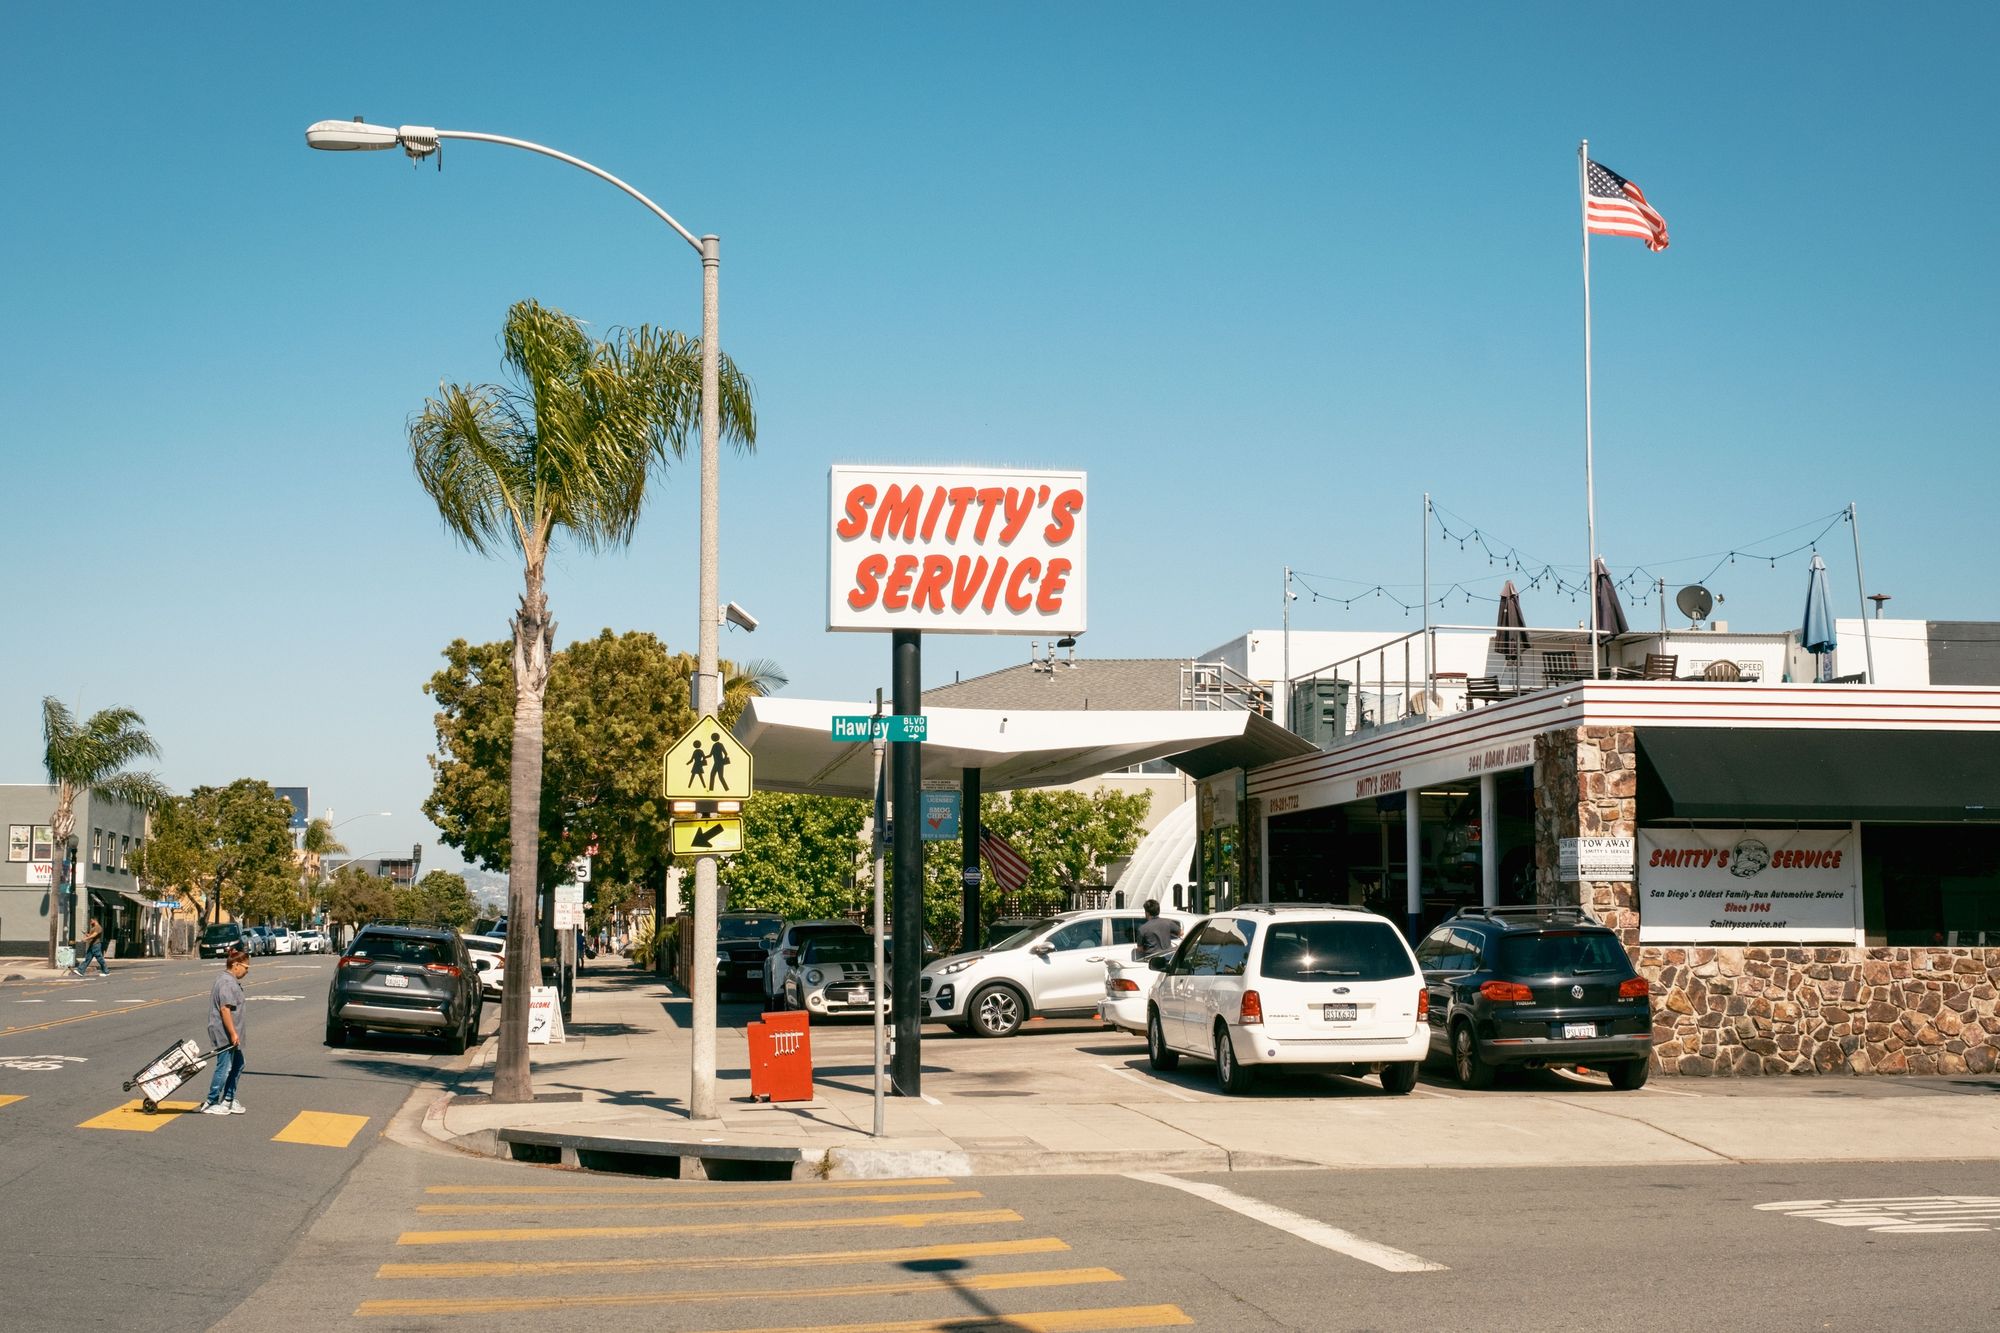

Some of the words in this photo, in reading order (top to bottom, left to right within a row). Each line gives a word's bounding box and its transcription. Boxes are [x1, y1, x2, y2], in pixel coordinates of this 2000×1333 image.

[837, 483, 1084, 547] SMITTY'S
[847, 553, 1073, 616] SERVICE
[1739, 663, 1762, 671] SPEED
[903, 717, 926, 725] BLVD
[835, 718, 890, 740] Hawley
[903, 725, 926, 733] 4700
[1484, 749, 1504, 770] ADAMS
[1506, 743, 1530, 765] AVENUE
[1356, 775, 1377, 798] SMITTY'S
[1380, 771, 1401, 793] SERVICE
[1582, 840, 1603, 848] TOW
[1605, 840, 1631, 848] AWAY
[1649, 848, 1730, 868] SMITTY'S
[1771, 849, 1843, 869] SERVICE
[1650, 889, 1665, 898] San
[1667, 889, 1696, 900] Diego's
[1698, 890, 1723, 899] Oldest
[1725, 890, 1769, 900] Family-Run
[1770, 890, 1814, 899] Automotive
[1816, 890, 1844, 899] Service
[1724, 903, 1747, 912] Since
[1709, 920, 1787, 931] Smittysservice.net
